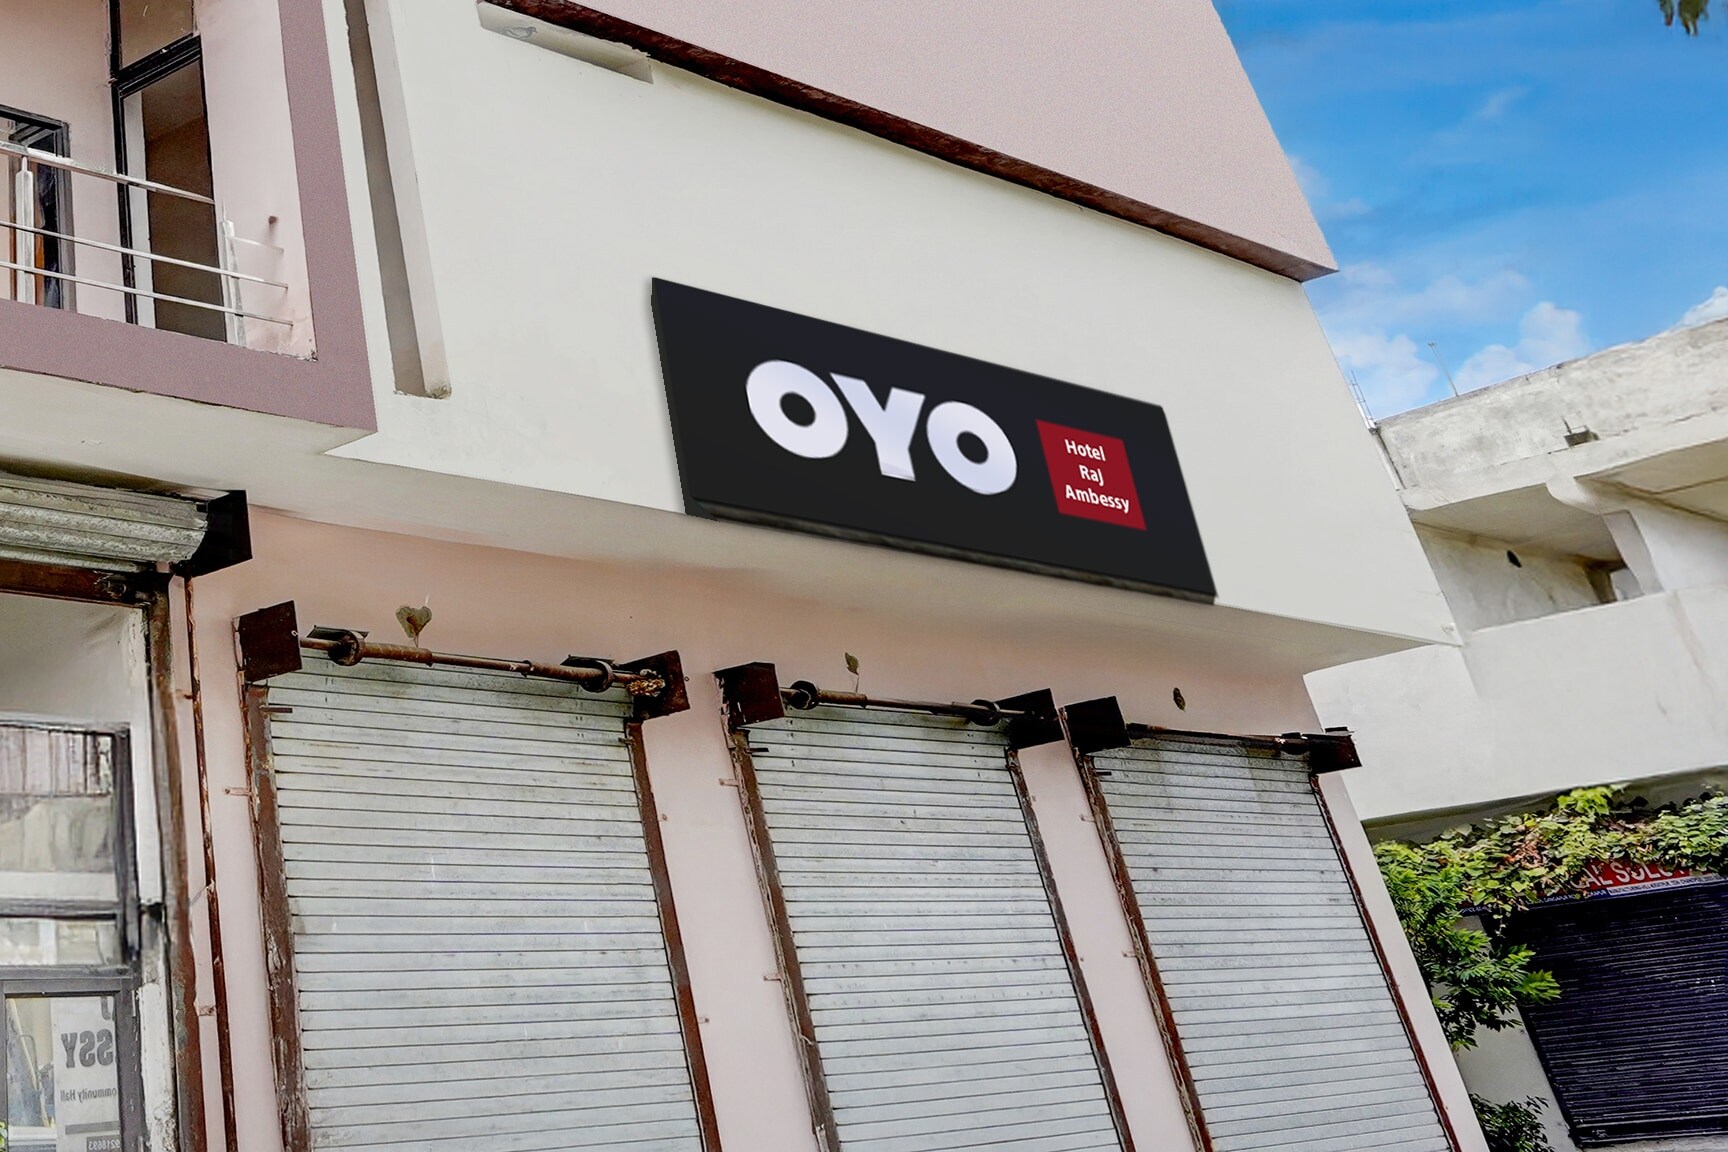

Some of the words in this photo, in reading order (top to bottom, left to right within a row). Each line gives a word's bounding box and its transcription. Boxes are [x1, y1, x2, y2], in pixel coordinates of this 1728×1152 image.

[745, 359, 1018, 496] OYO
[1064, 438, 1107, 462] Hotel
[1065, 484, 1130, 514] Ambessy
